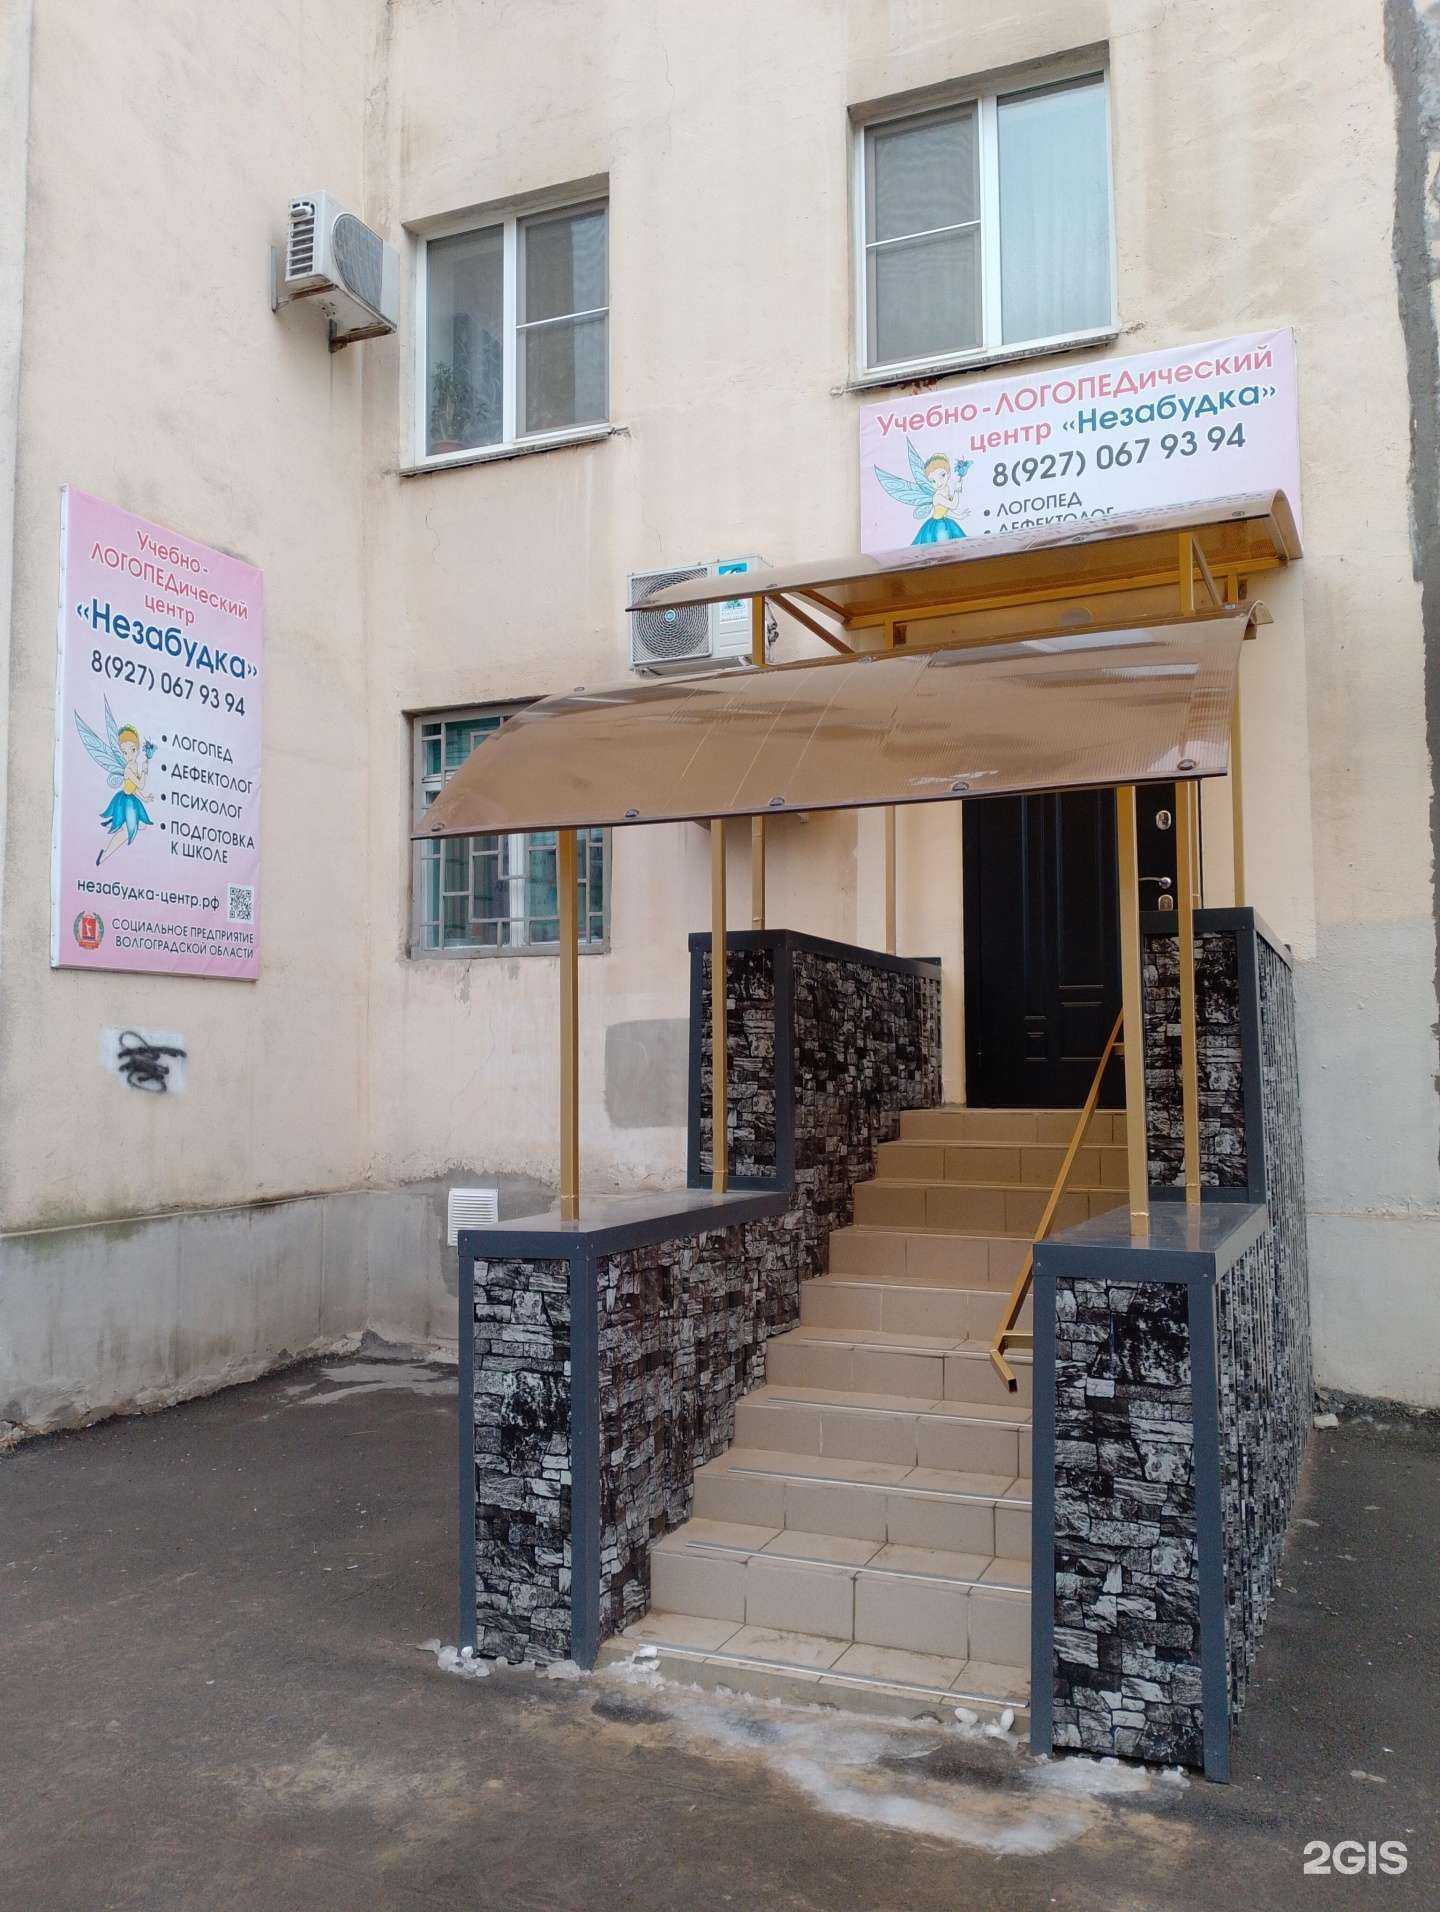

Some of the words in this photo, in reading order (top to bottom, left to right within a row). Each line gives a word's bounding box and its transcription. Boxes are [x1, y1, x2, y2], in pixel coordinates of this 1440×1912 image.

[970, 422, 1052, 453] центр
[1062, 385, 1276, 434] «Незабудка»
[992, 450, 1086, 487] 8(927)
[1096, 438, 1150, 470] 067
[1160, 430, 1198, 459] 93
[1207, 422, 1246, 451] 94
[997, 491, 1082, 517] ЛОГОПЕД
[136, 531, 208, 573] Учебно-
[91, 543, 248, 620] ЛОГОПЕДический
[145, 595, 195, 626] центр
[76, 598, 257, 679] «Незабудка»
[91, 650, 154, 691] 8(927)
[161, 672, 194, 700] 067
[199, 684, 220, 709] 93
[225, 692, 246, 717] 94
[172, 733, 233, 764] ЛОГОПЕД
[170, 763, 253, 794] ДЕФЕКТОЛОГ
[171, 791, 243, 820] ПСИХОЛОГ
[170, 820, 255, 850] ПОДГОТОВКА
[170, 841, 178, 856] К
[182, 843, 228, 864] ШКОЛЕ
[77, 879, 220, 911] незабудка-центр.рф
[111, 918, 189, 938] СОЦИАЛЬНОЕ
[190, 927, 254, 944] ПРЕДПРИЯТИЕ
[115, 936, 208, 955] ВОЛГОГРАДСКОЙ
[209, 945, 254, 959] ОБЛАСТИ
